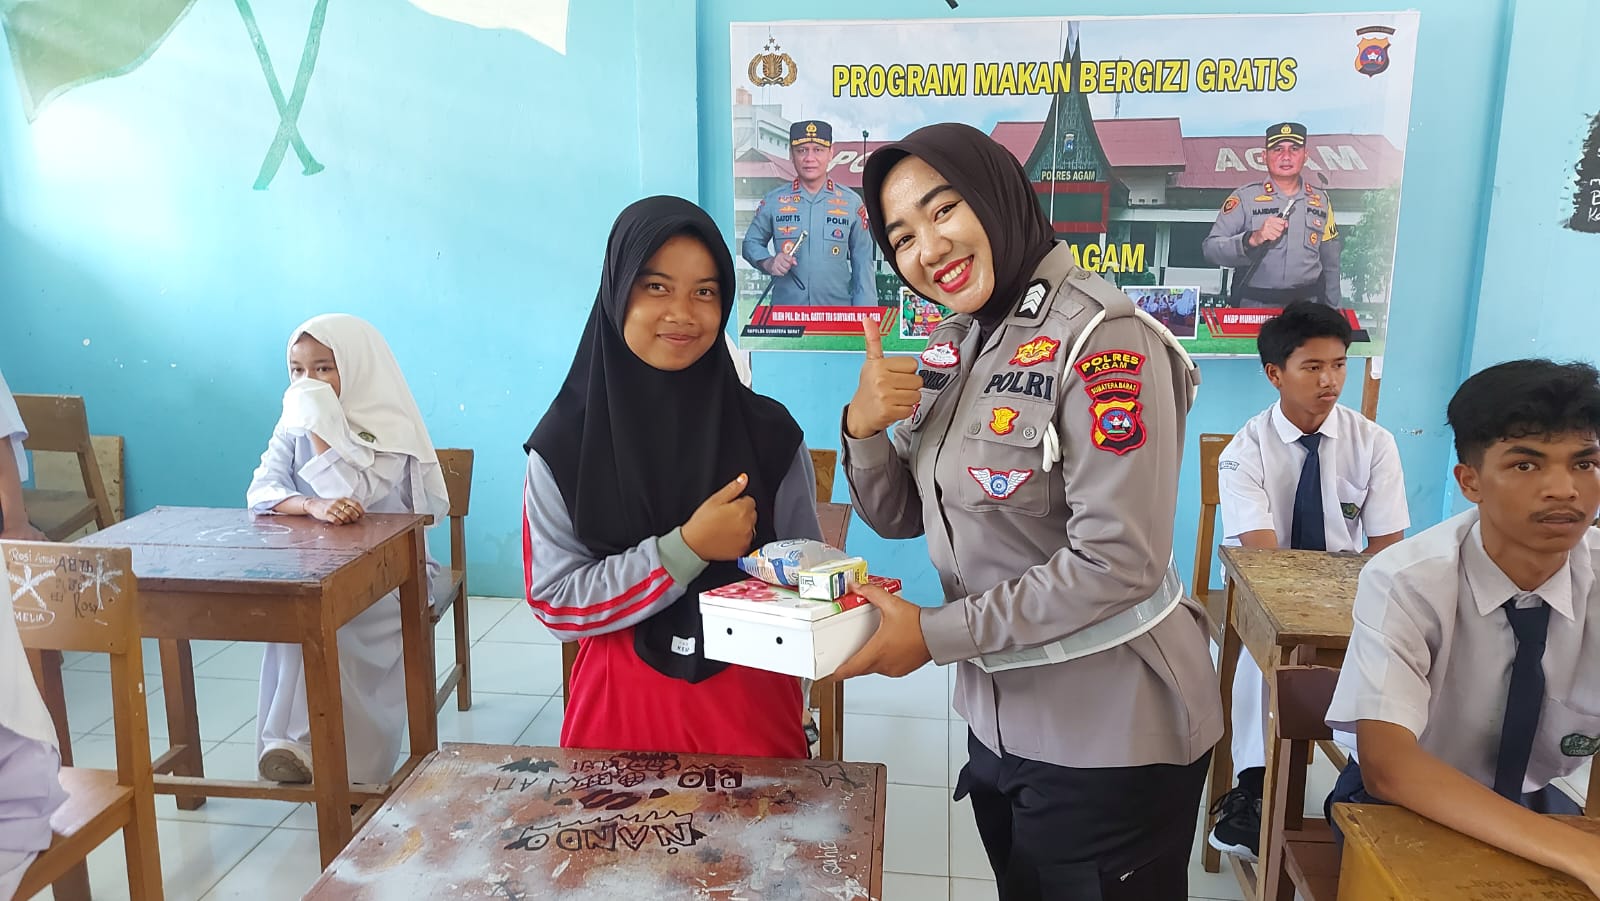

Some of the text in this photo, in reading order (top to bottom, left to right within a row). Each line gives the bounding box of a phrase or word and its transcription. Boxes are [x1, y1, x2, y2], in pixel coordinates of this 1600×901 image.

[832, 56, 1298, 97] PROGRAM MAKAN BERGIZI GRATIS
[1072, 170, 1096, 181] AGAM
[775, 215, 793, 223] GATOT
[826, 216, 849, 226] POLRI
[1070, 243, 1145, 273] AGAM
[1223, 314, 1272, 324] AKBP MUHAMM
[1081, 353, 1139, 373] POLRES
[1094, 361, 1128, 374] AGAM
[984, 371, 1053, 401] POLRI
[1090, 382, 1118, 395] SUMATERA
